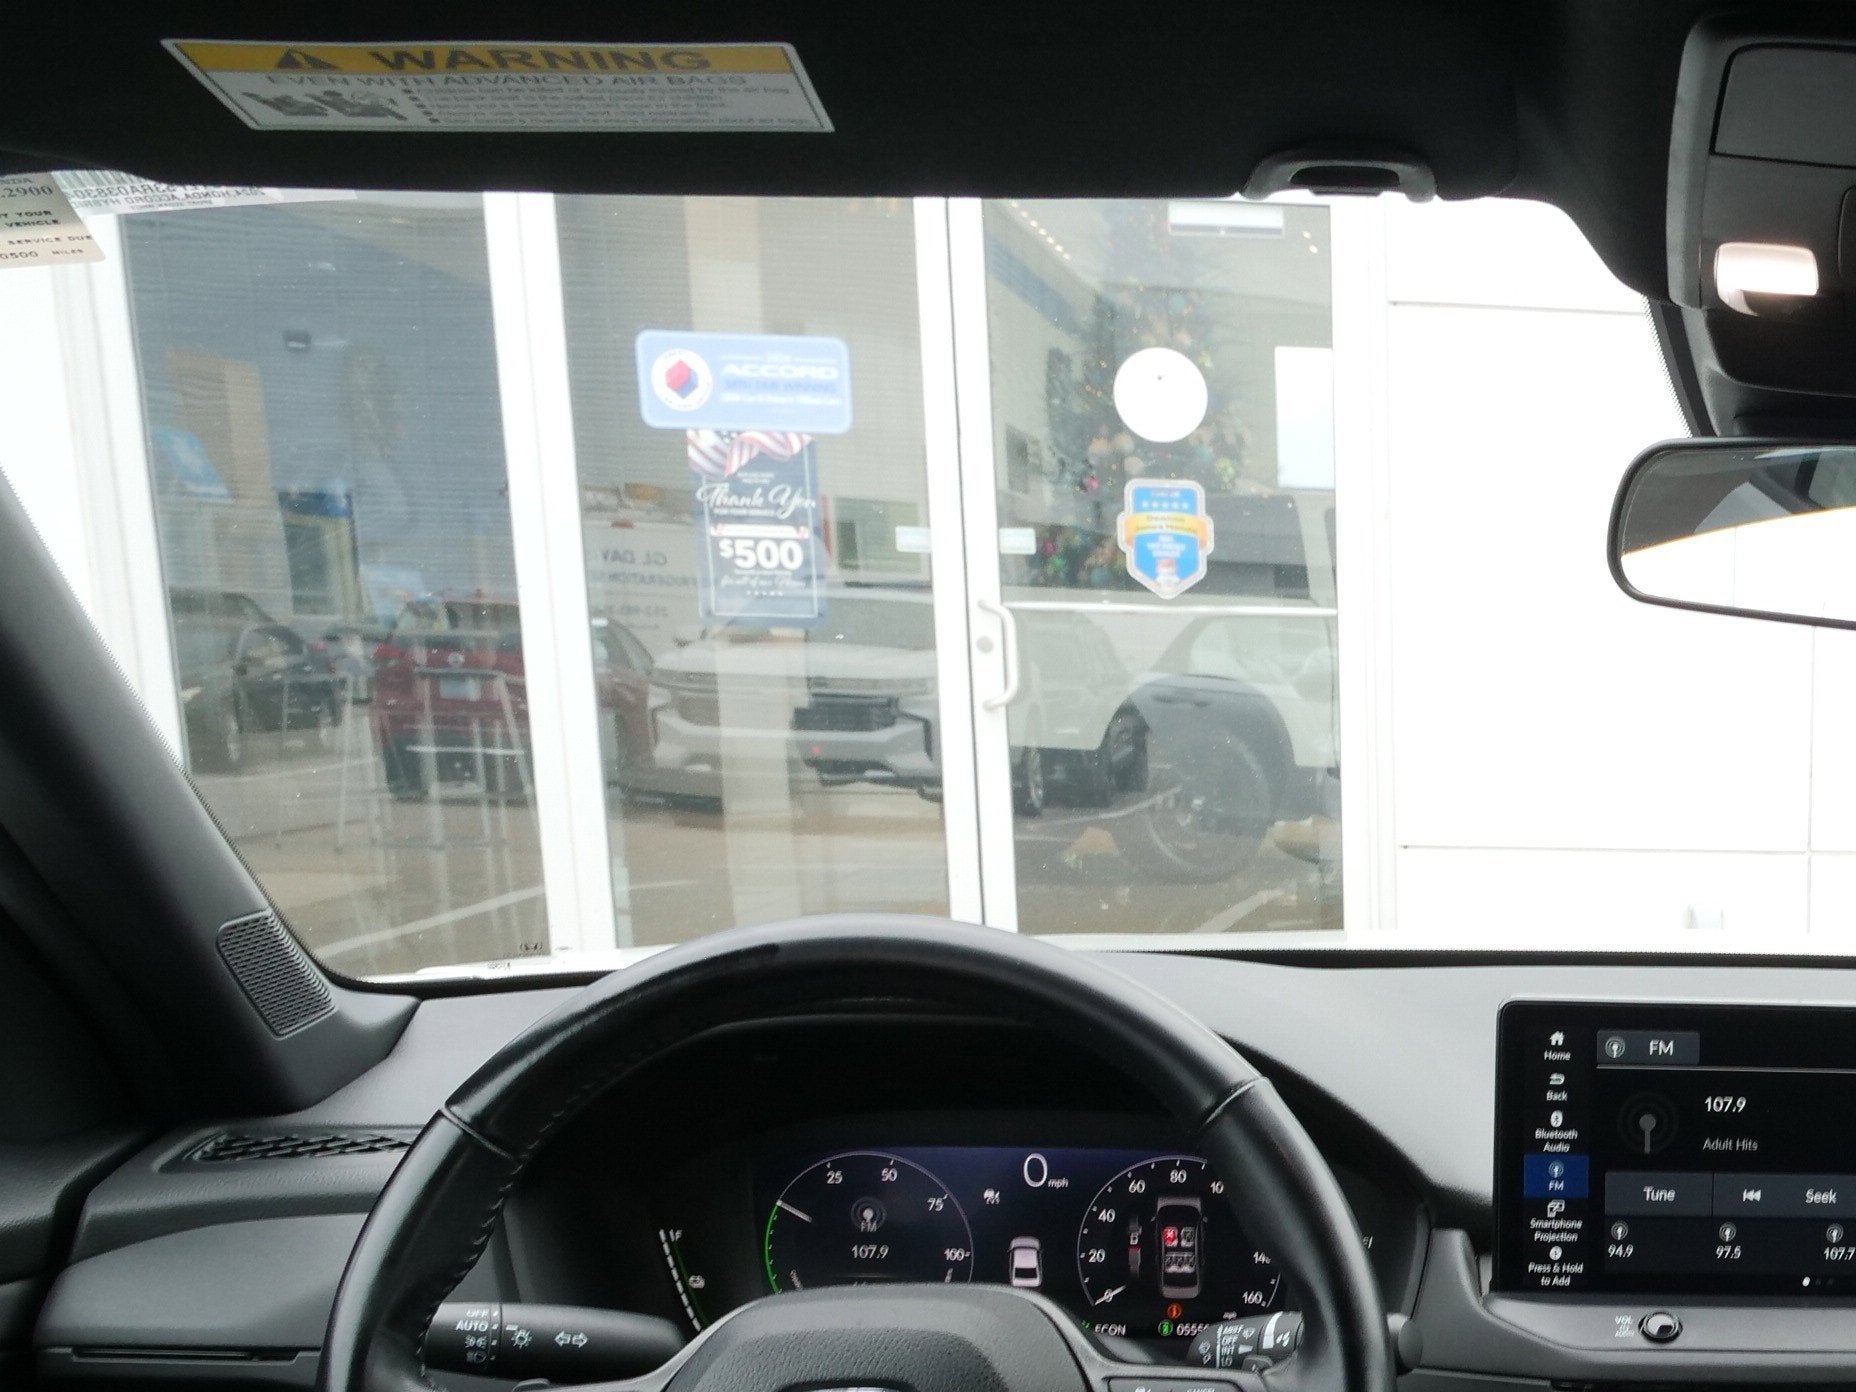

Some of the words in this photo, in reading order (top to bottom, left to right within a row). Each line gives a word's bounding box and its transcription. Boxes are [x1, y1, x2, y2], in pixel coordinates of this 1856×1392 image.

[366, 49, 711, 71] WARNING
[356, 74, 434, 87] WITH
[720, 362, 839, 380] ACCORD
[695, 481, 764, 509] Thank
[718, 537, 804, 571] $500
[1649, 1039, 1674, 1056] FM
[1543, 1049, 1571, 1061] Home
[1545, 1090, 1568, 1101] Back
[1704, 1096, 1747, 1113] 107.9
[1534, 1128, 1579, 1140] Bluetooth
[1543, 1141, 1571, 1153] Audio
[1703, 1137, 1733, 1151] Adult
[1735, 1138, 1759, 1151] Hits
[826, 1170, 843, 1184] 25
[881, 1168, 898, 1182] 50
[1022, 1152, 1048, 1188] 0
[1048, 1177, 1069, 1190] mph
[1169, 1169, 1187, 1184] 80
[1128, 1179, 1146, 1194] 60
[1548, 1181, 1565, 1192] FM
[1643, 1186, 1676, 1202] Tune
[1805, 1188, 1838, 1205] Seek
[926, 1197, 945, 1212] 75
[1098, 1209, 1116, 1223] 40
[860, 1221, 877, 1233] FM
[1529, 1219, 1583, 1231] Smartphone
[1533, 1231, 1579, 1243] Projection
[851, 1244, 890, 1259] 107.9
[944, 1248, 965, 1261] 100
[1088, 1249, 1106, 1263] 20
[1607, 1244, 1635, 1258] 94.9
[1715, 1245, 1742, 1260] 97.5
[1823, 1246, 1856, 1261] 107.7
[1527, 1262, 1551, 1273] Press
[1552, 1262, 1561, 1273] &
[1562, 1262, 1584, 1274] Hold
[1540, 1276, 1550, 1286] to
[1551, 1275, 1571, 1287] Add
[1241, 1291, 1264, 1305] 160
[466, 1308, 489, 1318] OFF
[455, 1320, 489, 1333] AUTO
[1220, 1334, 1240, 1346] OFF
